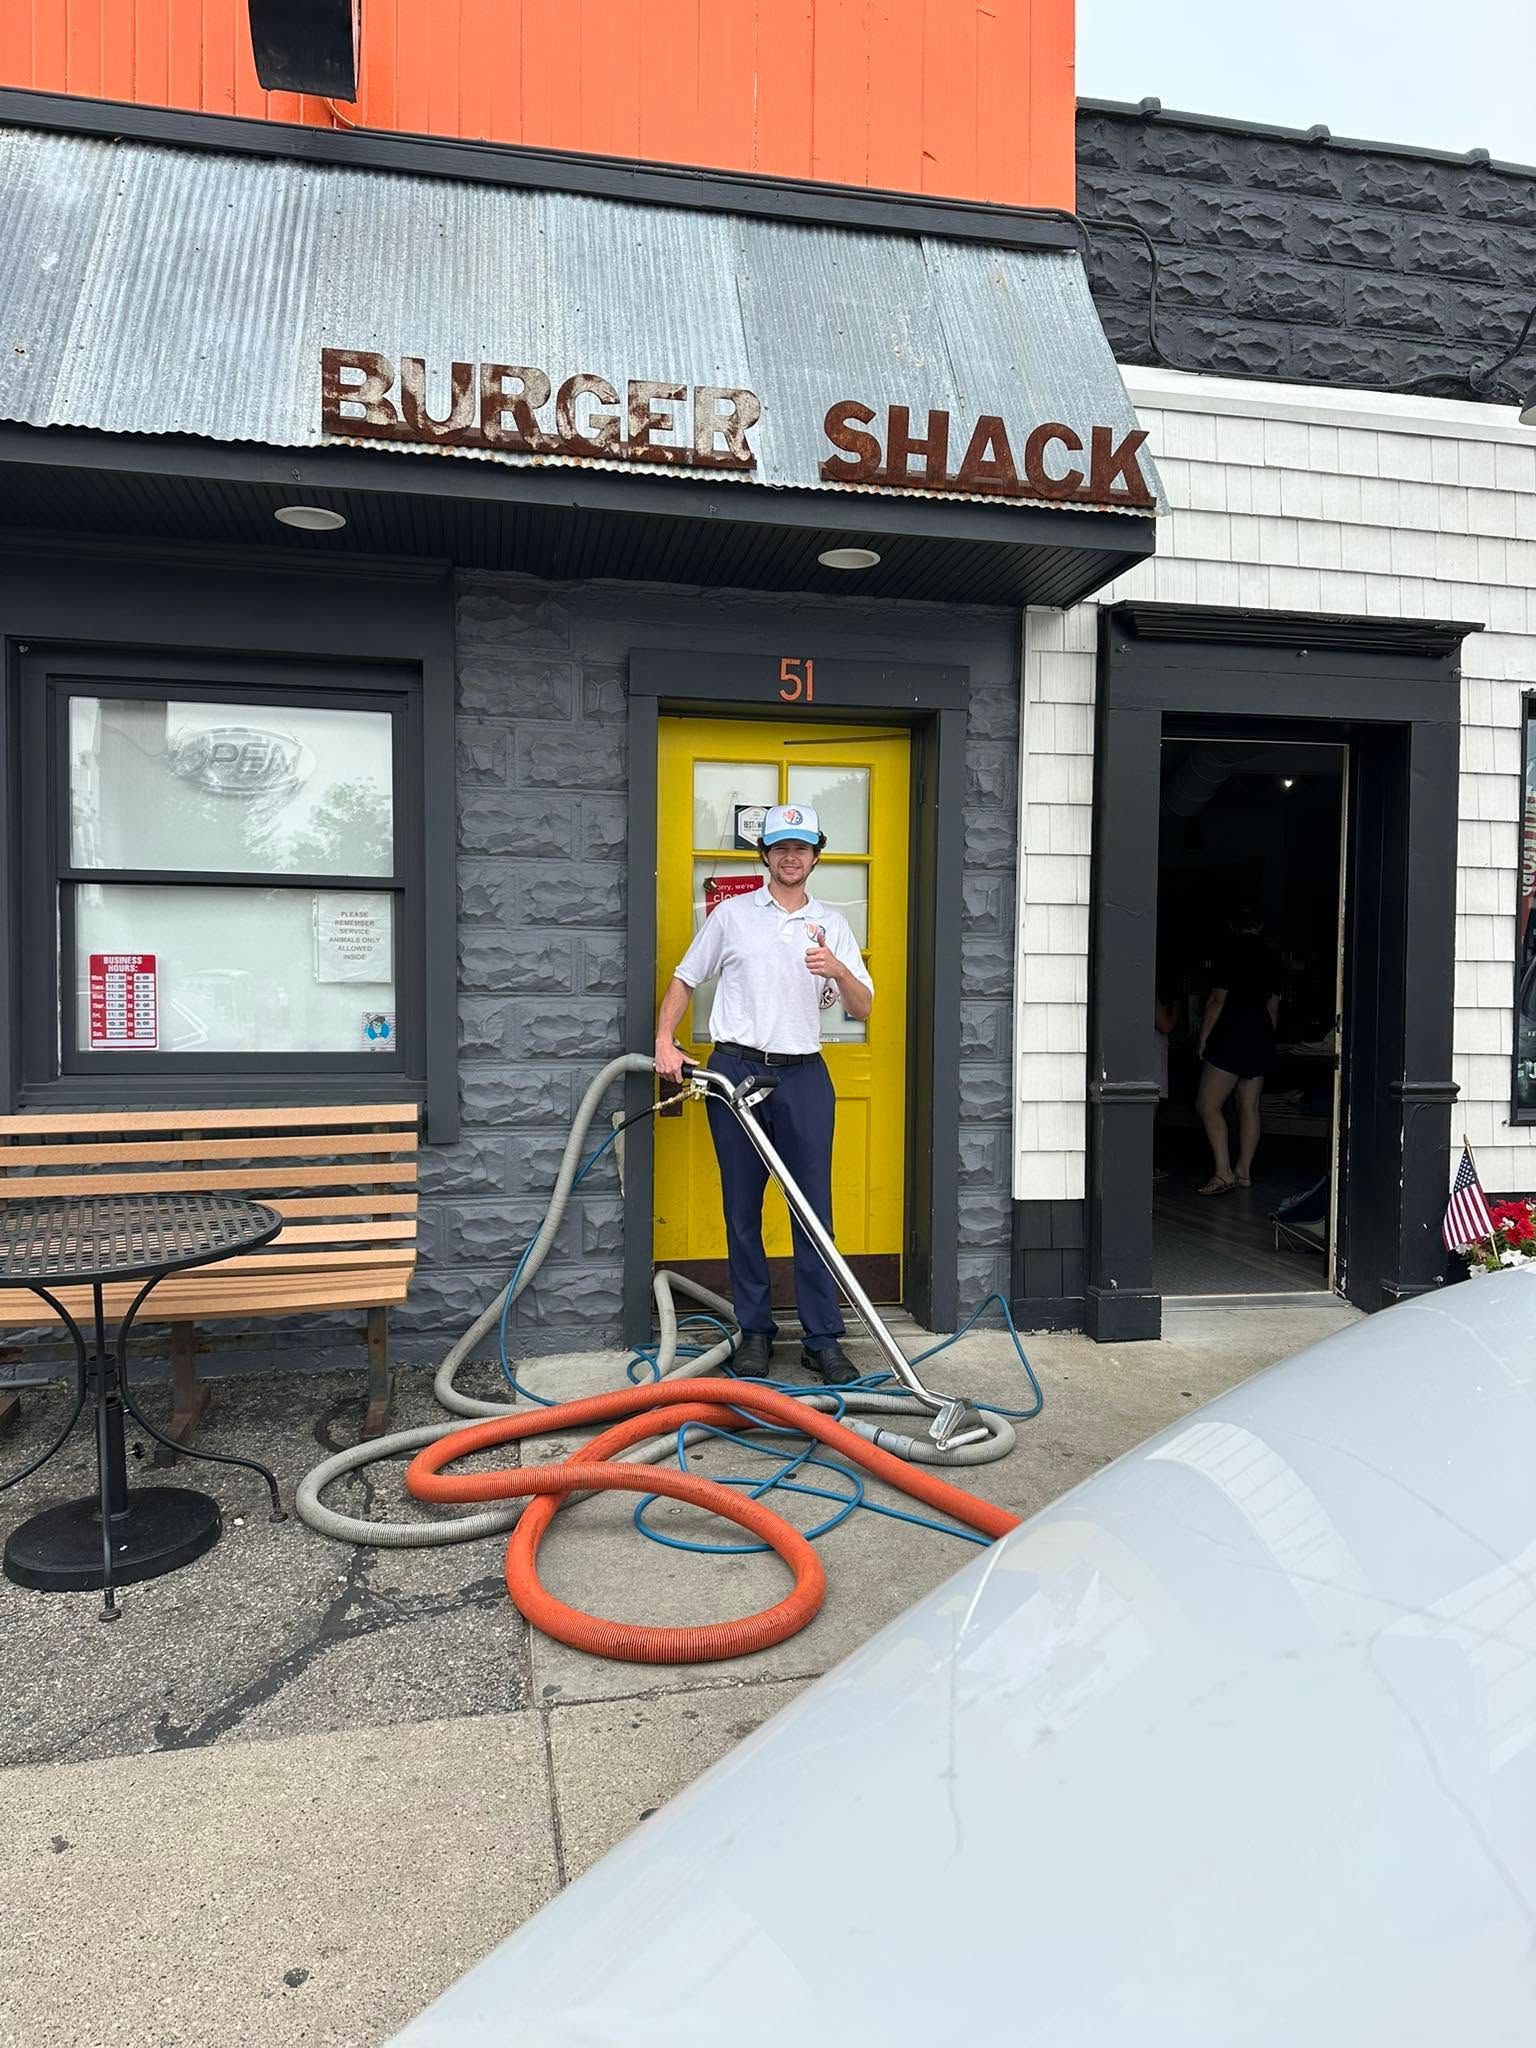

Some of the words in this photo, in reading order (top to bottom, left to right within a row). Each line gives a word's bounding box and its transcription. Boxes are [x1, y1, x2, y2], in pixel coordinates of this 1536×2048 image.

[321, 348, 761, 464] BURGER
[824, 400, 1150, 504] SHACK
[779, 658, 814, 702] 51
[103, 956, 143, 965] BUSINESS
